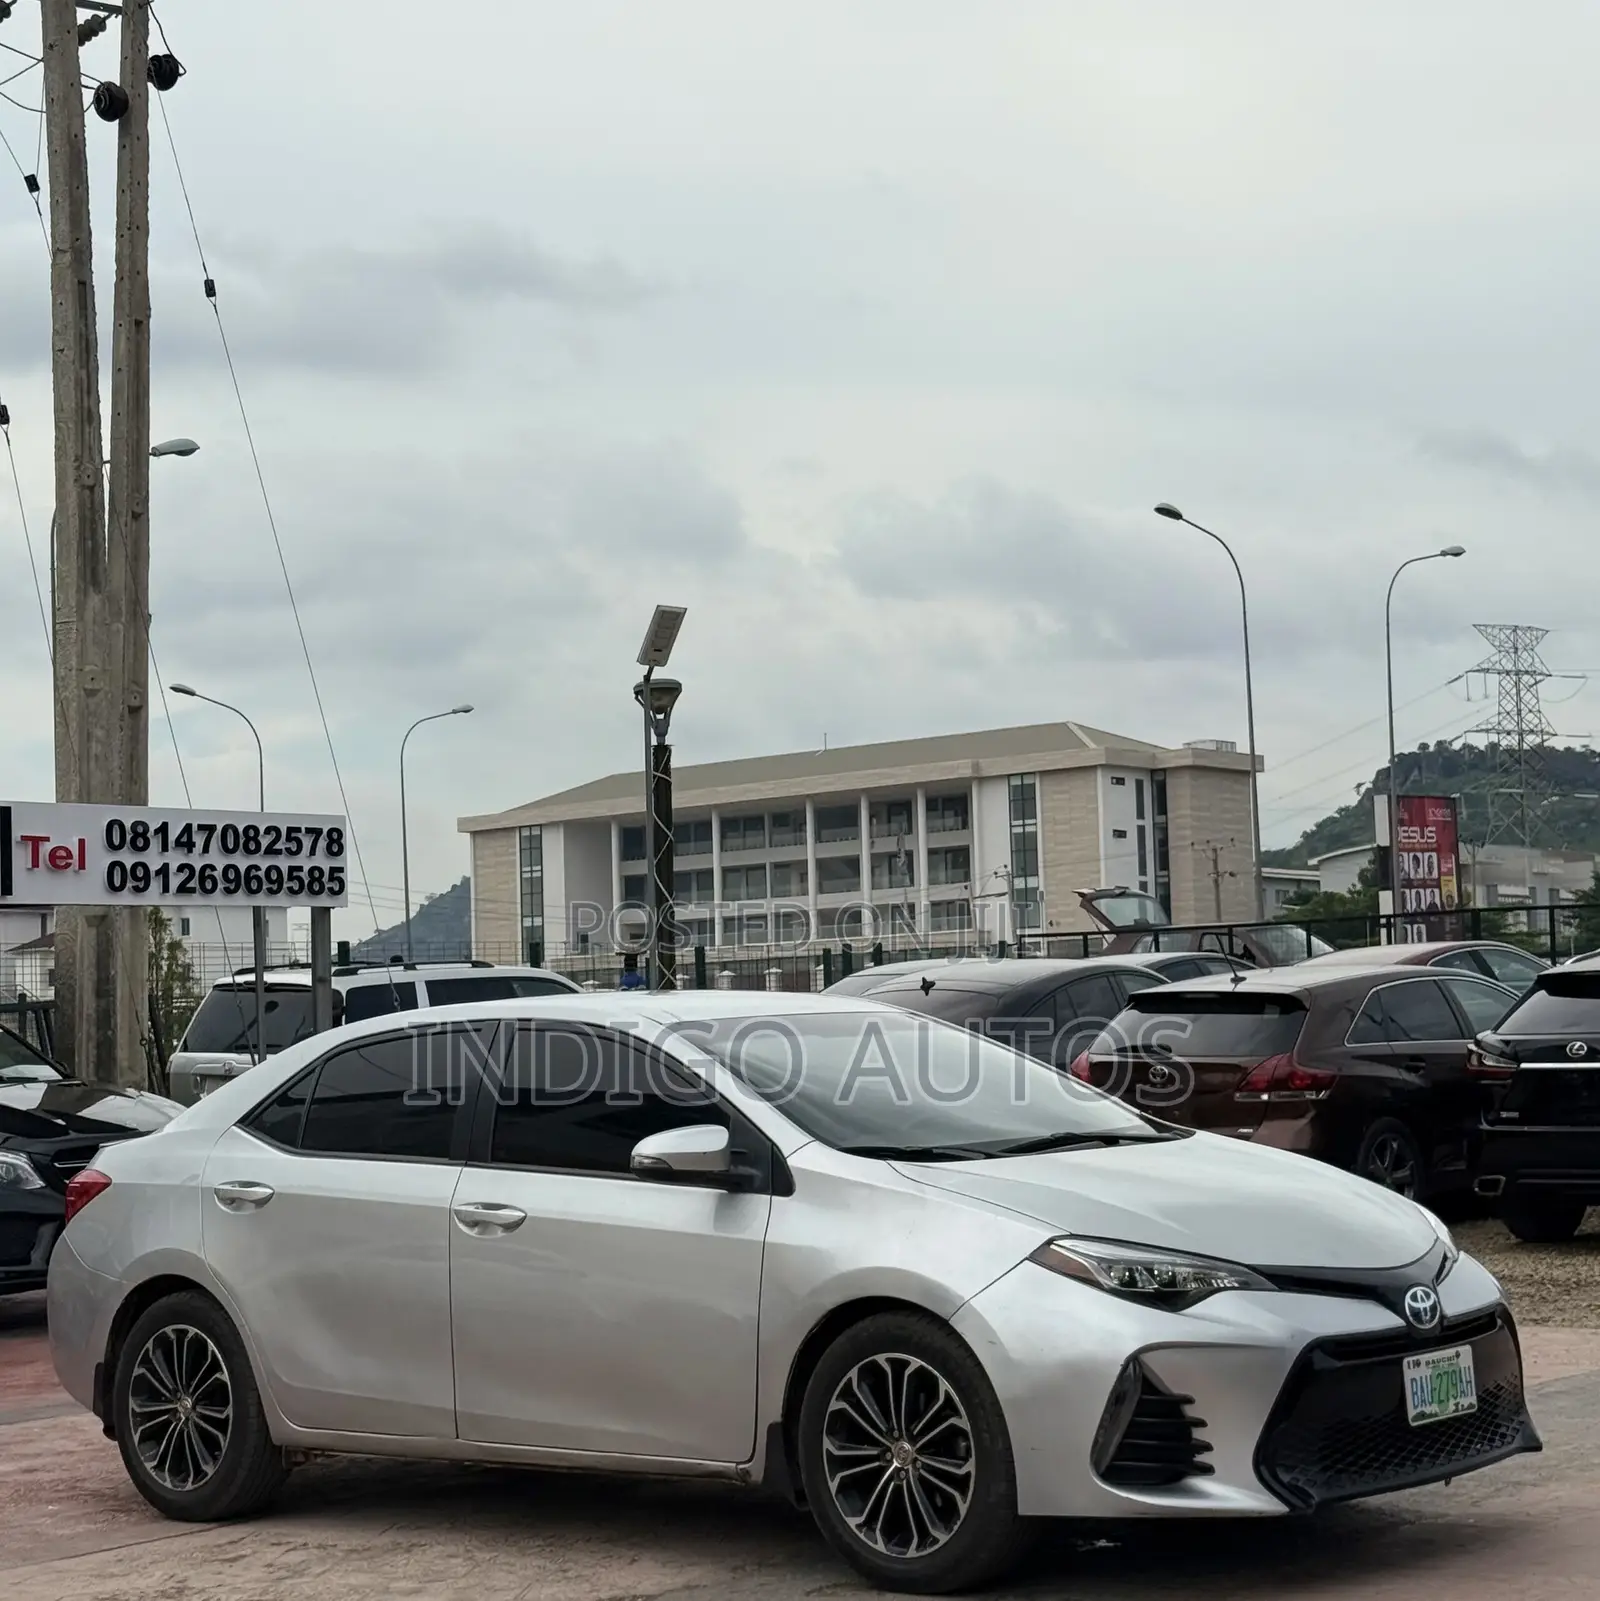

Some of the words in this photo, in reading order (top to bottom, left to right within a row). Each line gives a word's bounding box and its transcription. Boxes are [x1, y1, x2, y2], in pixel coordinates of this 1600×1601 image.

[20, 834, 86, 870] Tel
[105, 819, 344, 857] 08147082578
[106, 861, 345, 896] 09126969585
